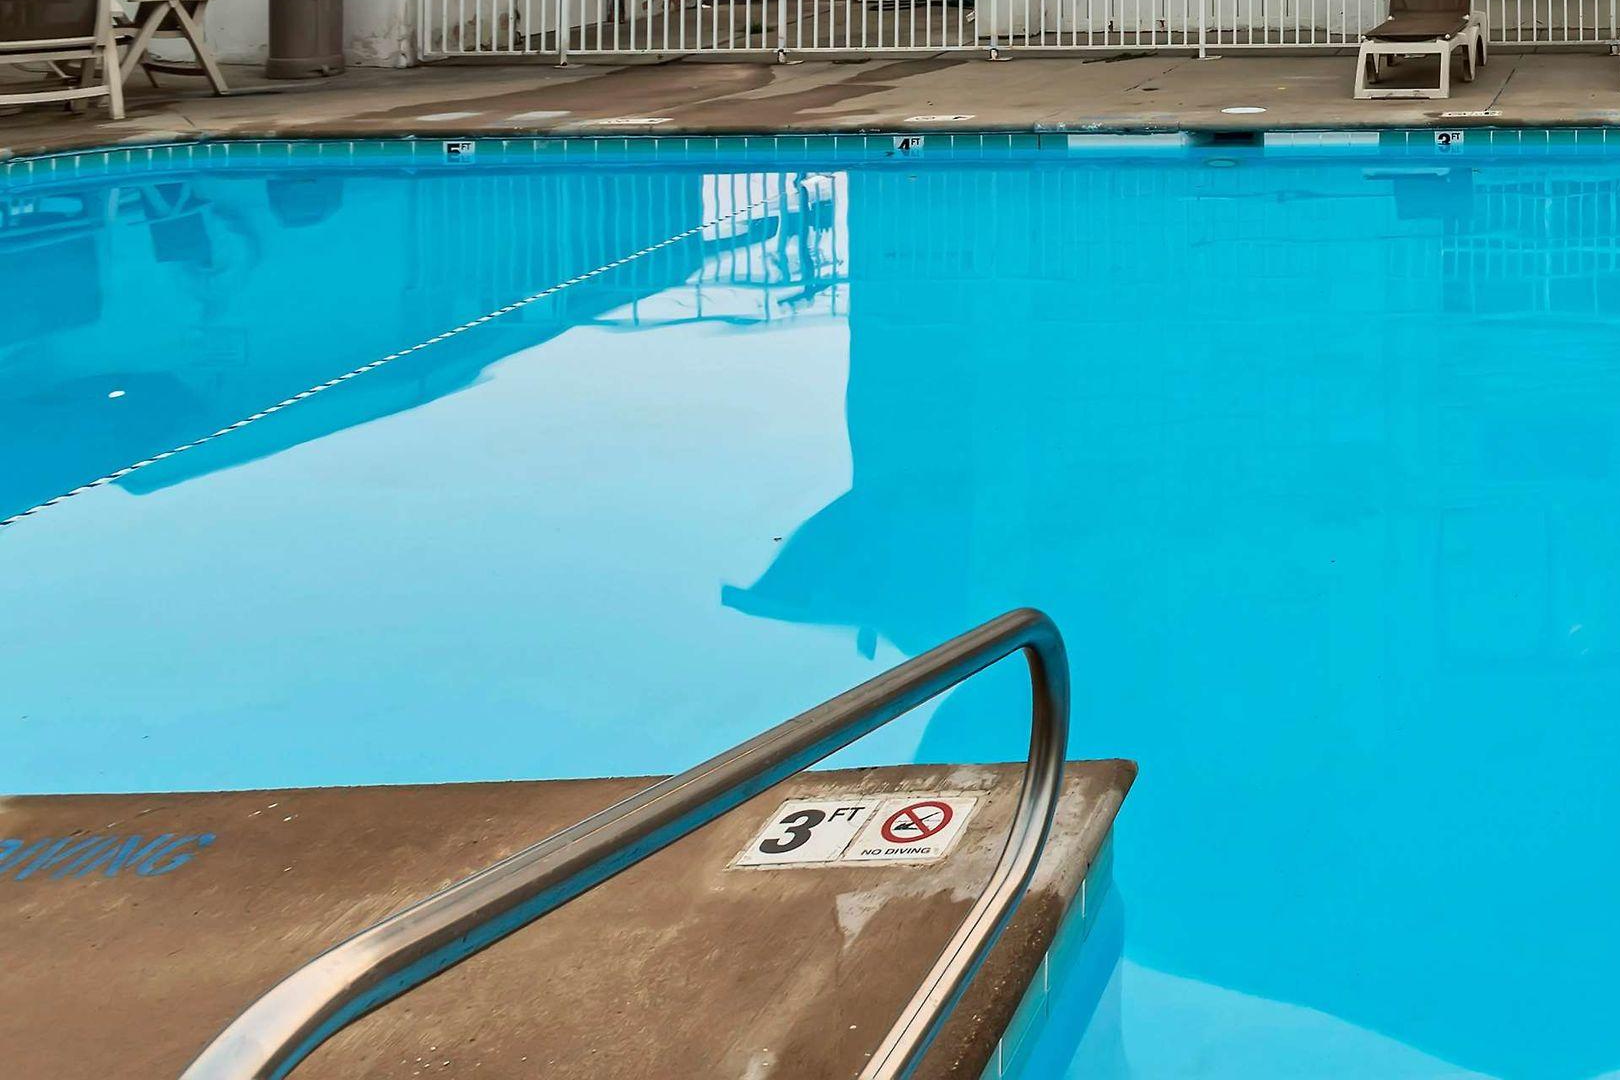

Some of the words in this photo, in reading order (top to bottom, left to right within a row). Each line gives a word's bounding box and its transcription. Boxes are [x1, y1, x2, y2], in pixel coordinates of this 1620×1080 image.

[758, 808, 827, 855] 3
[826, 806, 866, 823] FT
[860, 848, 882, 856] NO
[884, 846, 932, 856] DIVING
